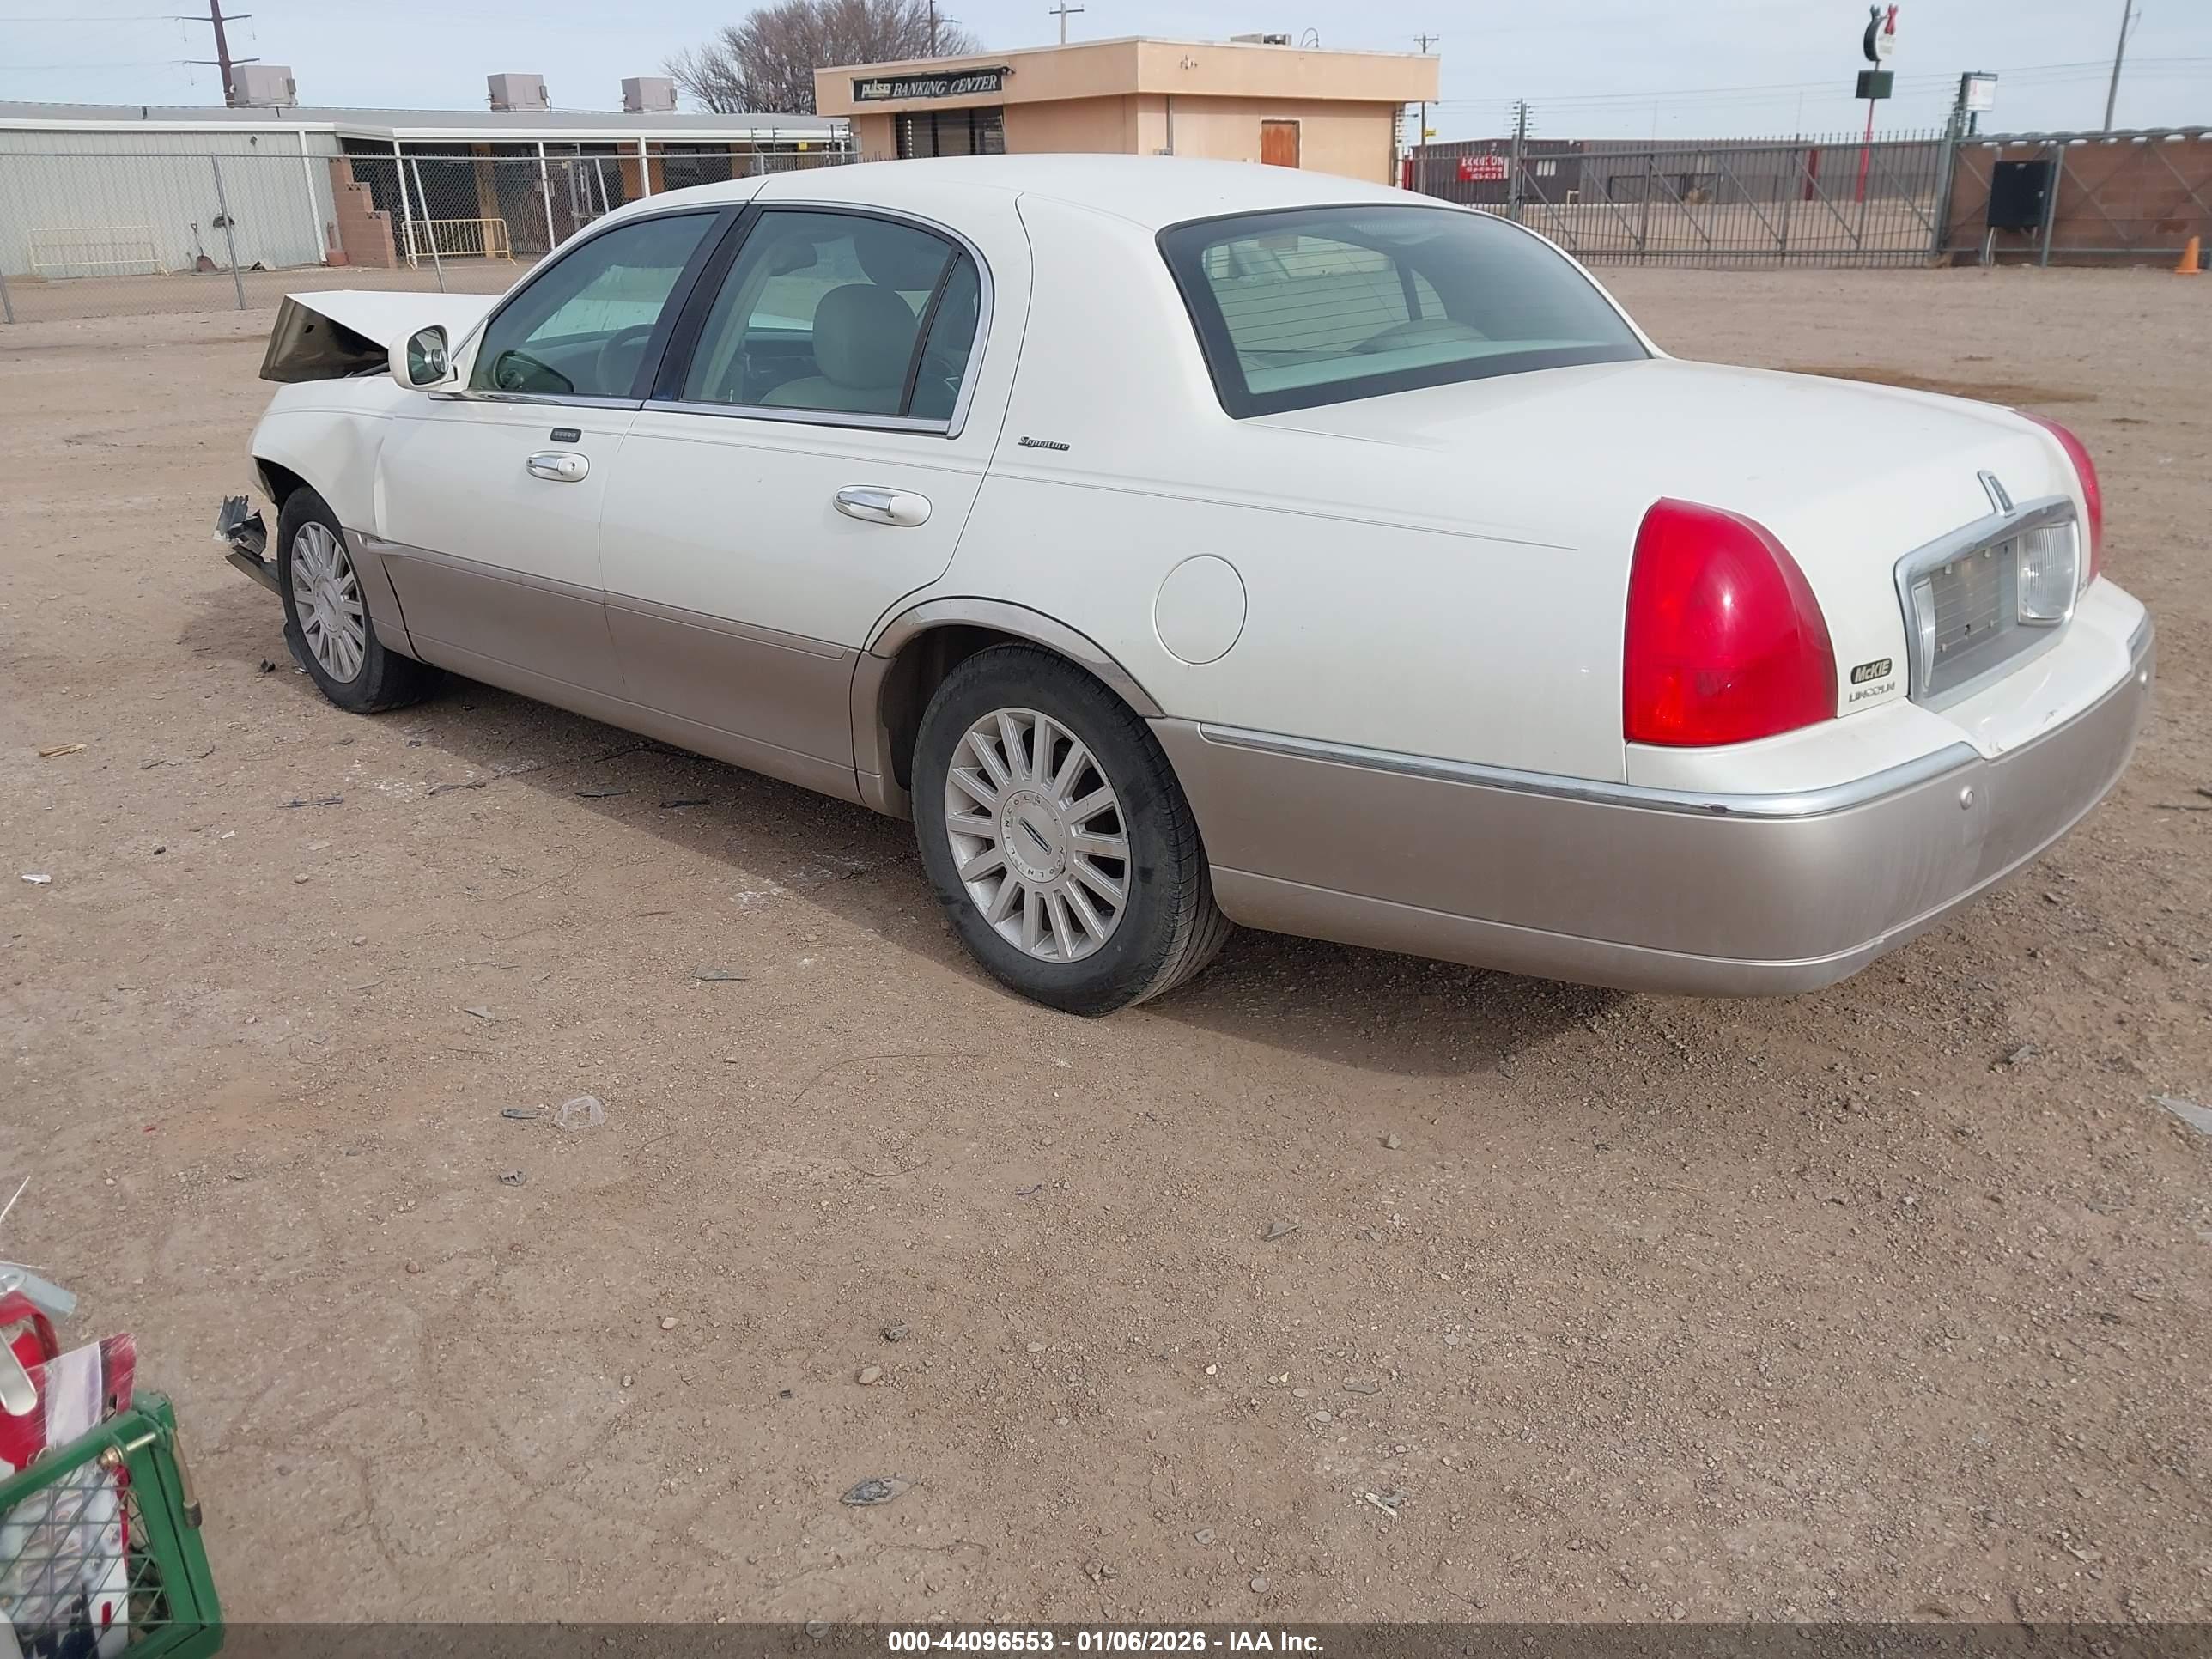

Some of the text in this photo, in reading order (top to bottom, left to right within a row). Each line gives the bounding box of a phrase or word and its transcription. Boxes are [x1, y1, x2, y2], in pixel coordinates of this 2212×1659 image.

[892, 81, 947, 97] BANKING
[950, 75, 997, 94] CENTER
[1018, 436, 1070, 451] Signature
